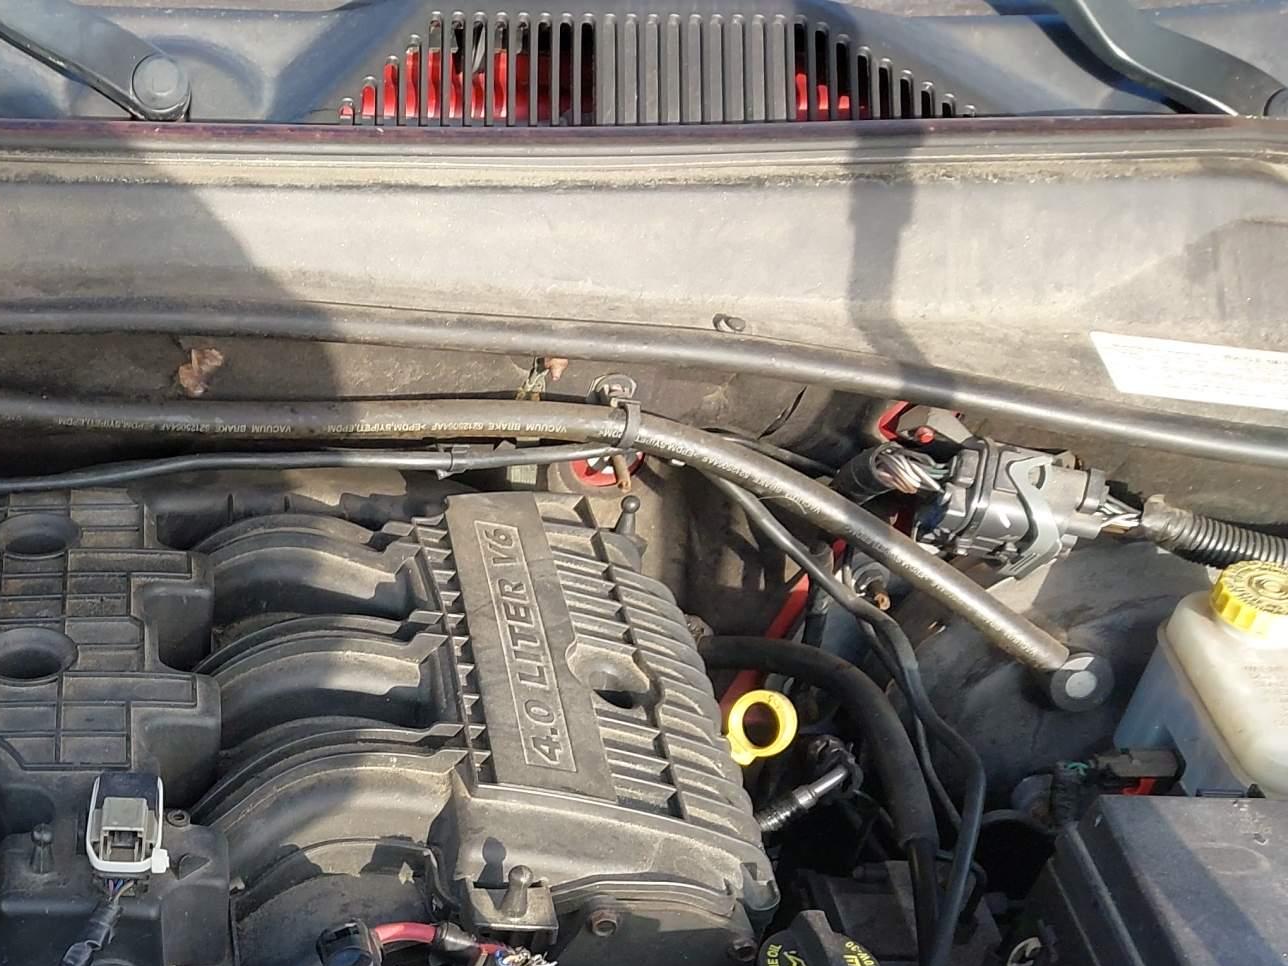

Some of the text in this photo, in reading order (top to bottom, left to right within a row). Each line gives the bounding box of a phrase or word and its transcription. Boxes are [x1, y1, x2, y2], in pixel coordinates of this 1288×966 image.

[251, 422, 292, 433] VACUUM
[487, 422, 522, 432] BRAKE
[525, 423, 568, 434] VACUUM
[483, 527, 562, 764] 4.0 LITER V6
[767, 944, 782, 958] OIL
